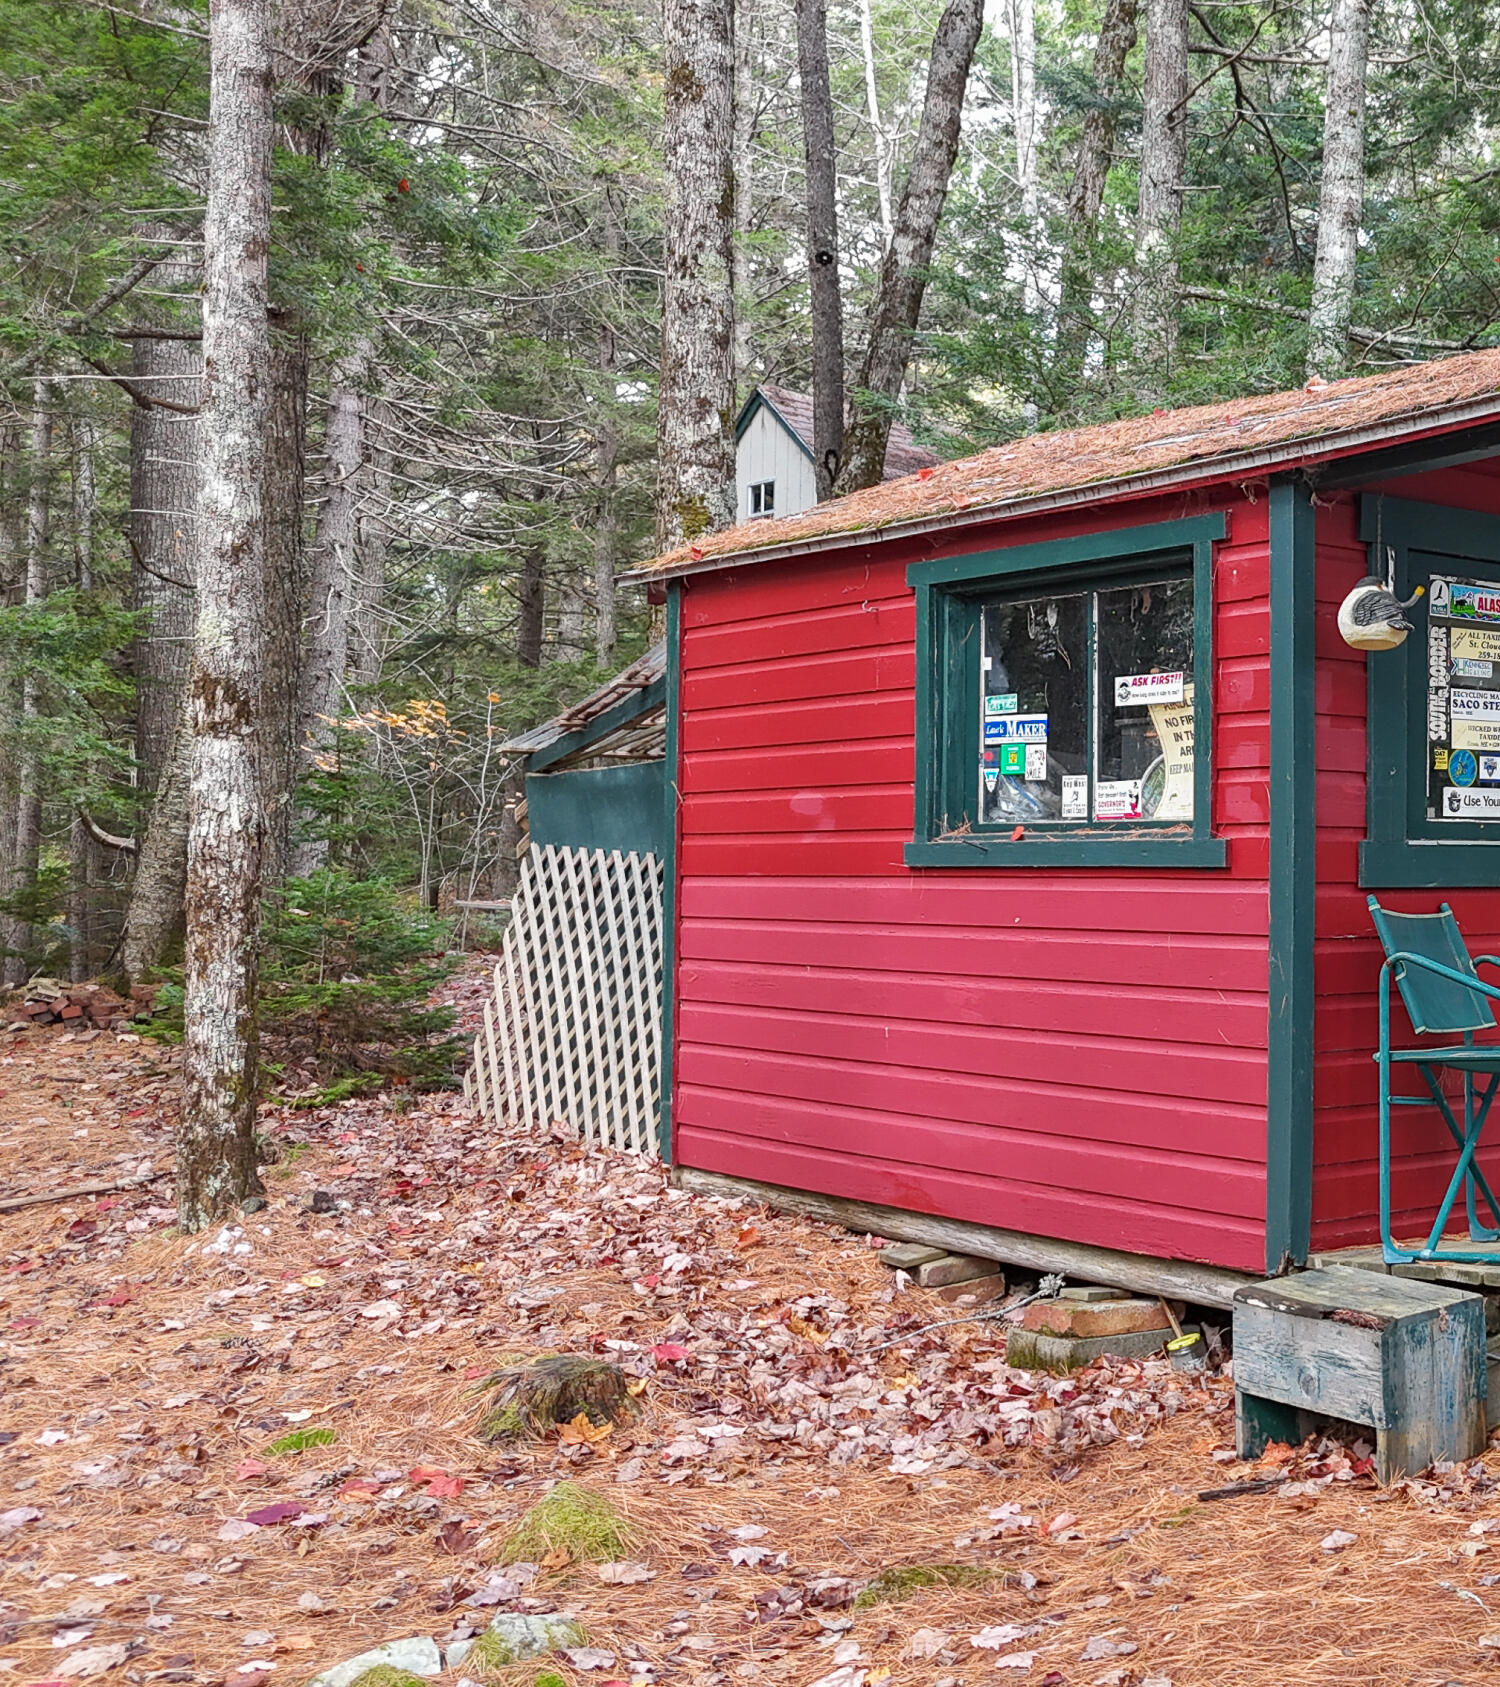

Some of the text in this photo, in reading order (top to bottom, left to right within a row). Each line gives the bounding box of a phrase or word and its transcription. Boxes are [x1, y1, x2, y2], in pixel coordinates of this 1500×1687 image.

[1468, 631, 1480, 639] ALL
[1469, 640, 1479, 648] St.
[1429, 626, 1447, 687] BORDER
[1131, 673, 1182, 687] ASK FIRST!!
[1453, 690, 1488, 700] RECYCLING
[1452, 699, 1480, 709] SACO
[1164, 714, 1195, 728] NO FIR
[1429, 695, 1447, 741] SOUTH
[1006, 720, 1047, 737] MAKER
[1173, 729, 1195, 743] IN TH
[1180, 745, 1195, 757] AR
[1463, 795, 1481, 807] Use
